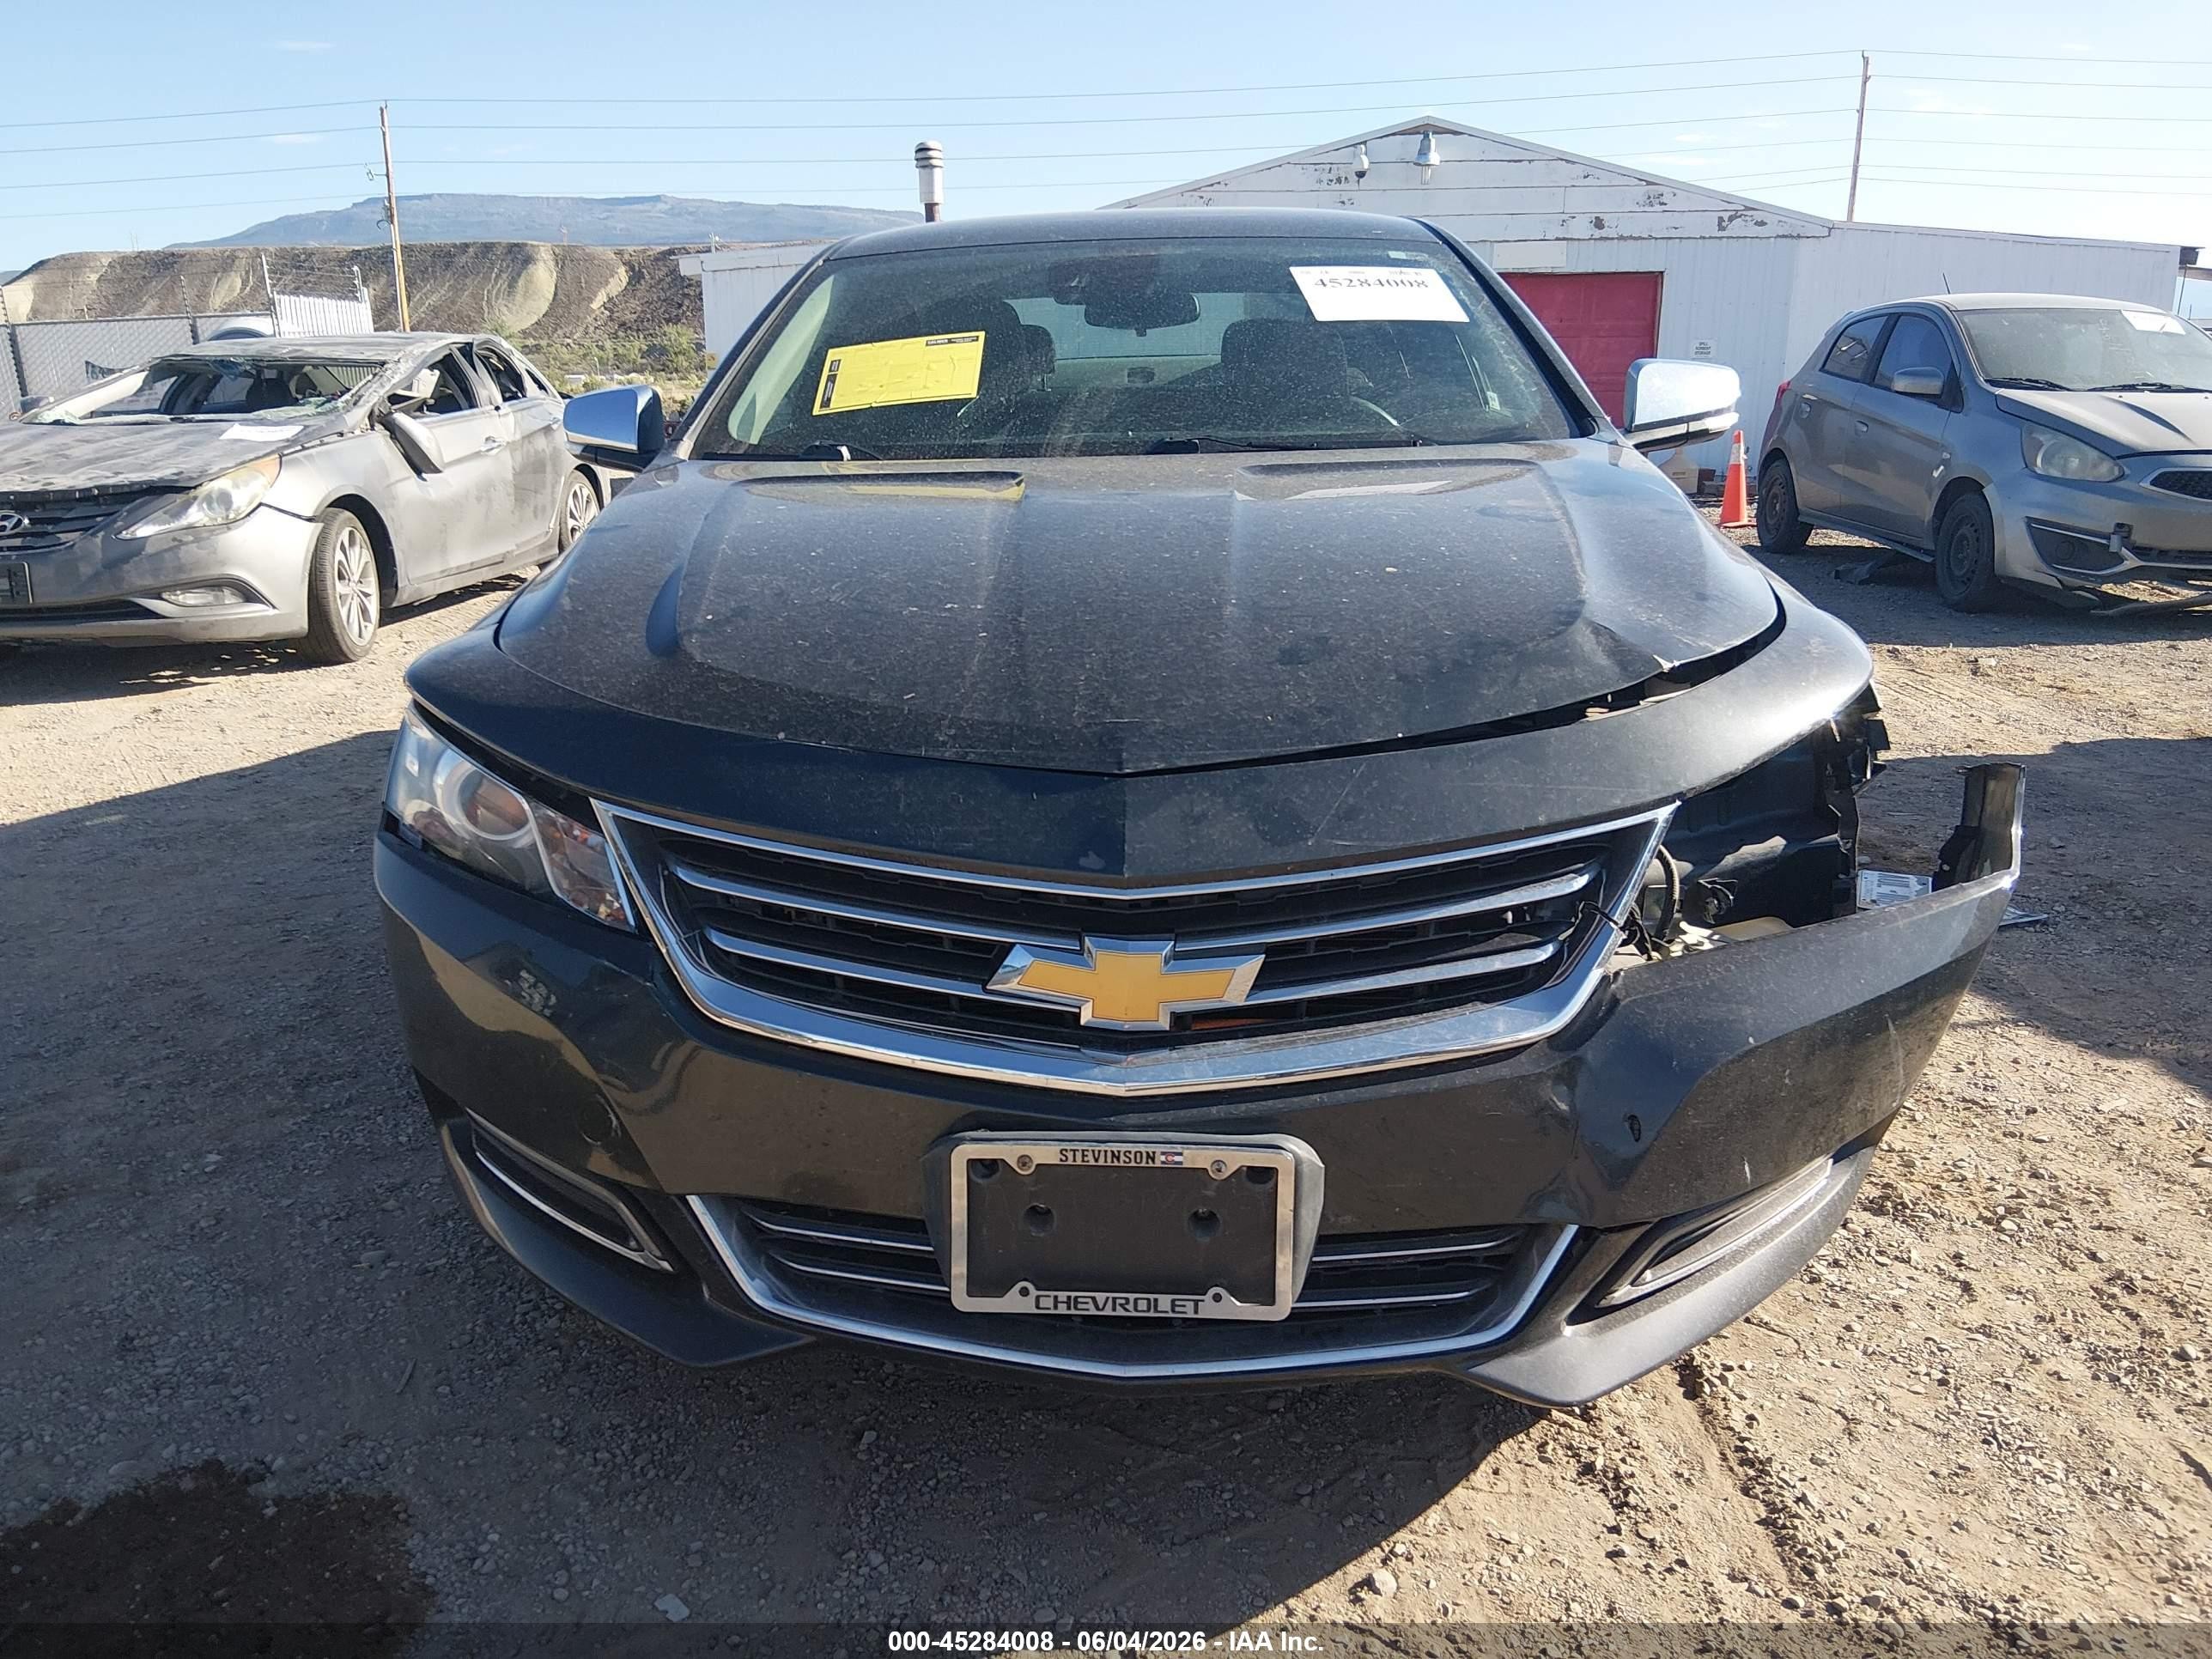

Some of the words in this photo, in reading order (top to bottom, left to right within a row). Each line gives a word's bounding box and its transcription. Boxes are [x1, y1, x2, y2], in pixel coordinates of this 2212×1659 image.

[1314, 278, 1429, 289] 45284008
[1059, 1149, 1157, 1165] STEVINSON
[1035, 1295, 1205, 1315] CHEVROLET
